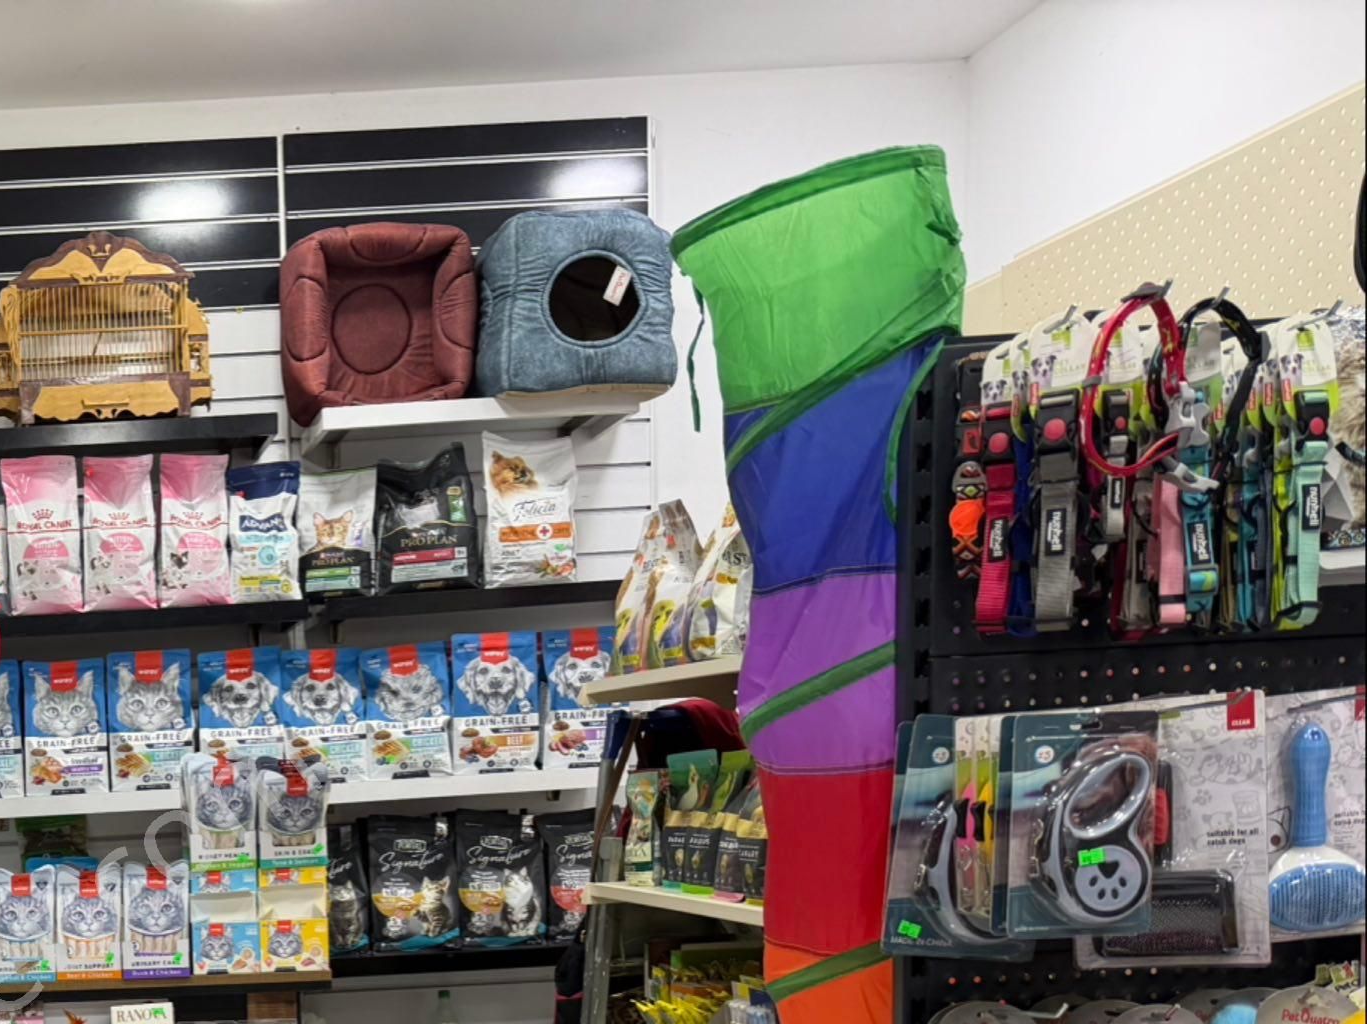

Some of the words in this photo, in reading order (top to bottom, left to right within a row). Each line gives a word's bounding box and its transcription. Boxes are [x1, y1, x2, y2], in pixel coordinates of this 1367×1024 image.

[17, 520, 43, 531] ROYAL
[45, 519, 73, 531] CANIN
[241, 517, 284, 532] ADVAN
[400, 537, 425, 548] PRO
[426, 534, 459, 546] PLAN
[464, 715, 530, 727] GRAIN-FREE
[555, 709, 608, 722] GRAIN-FR
[376, 718, 442, 730] GRAIN-FREE
[209, 726, 274, 739] GRAIN-FREE
[294, 726, 356, 736] GRAIN-FREE
[36, 736, 96, 748] GRAIN-FREE
[120, 732, 183, 744] GRAIN-FREE
[378, 850, 445, 875] Signature
[467, 845, 532, 870] Signature
